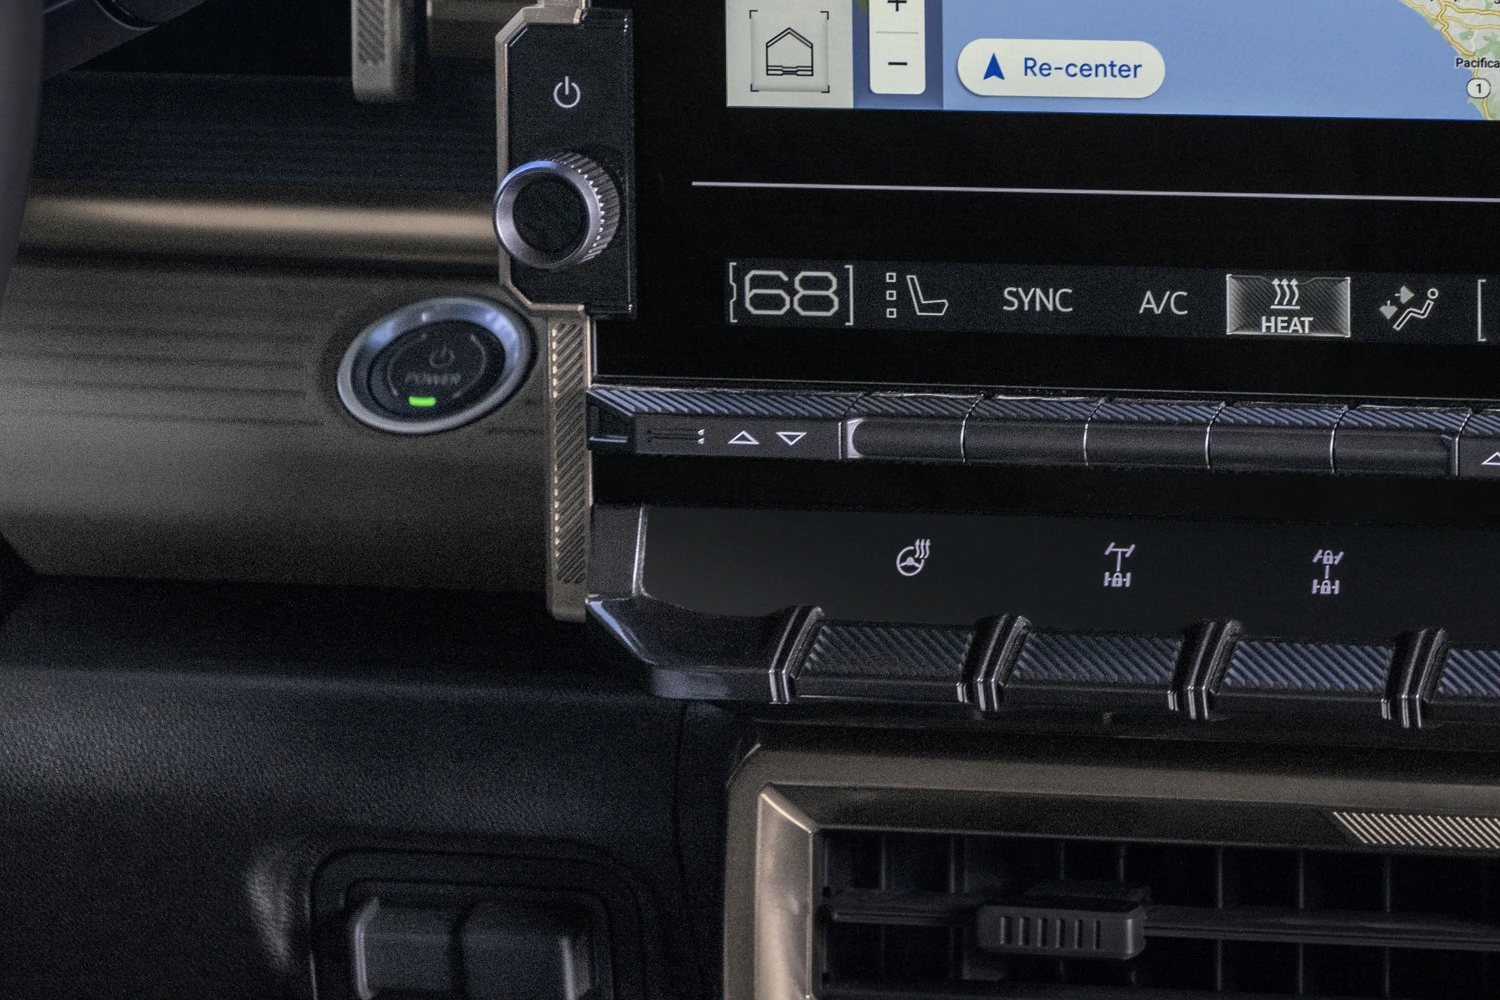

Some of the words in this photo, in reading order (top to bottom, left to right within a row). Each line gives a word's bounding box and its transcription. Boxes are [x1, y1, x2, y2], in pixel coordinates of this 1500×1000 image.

[1024, 58, 1142, 79] Re-center
[1456, 58, 1500, 69] Pacifica
[1476, 84, 1482, 94] 1
[744, 270, 839, 316] 68
[1003, 288, 1073, 313] SYNC
[1140, 292, 1188, 315] A/C
[1261, 316, 1313, 334] HEAT
